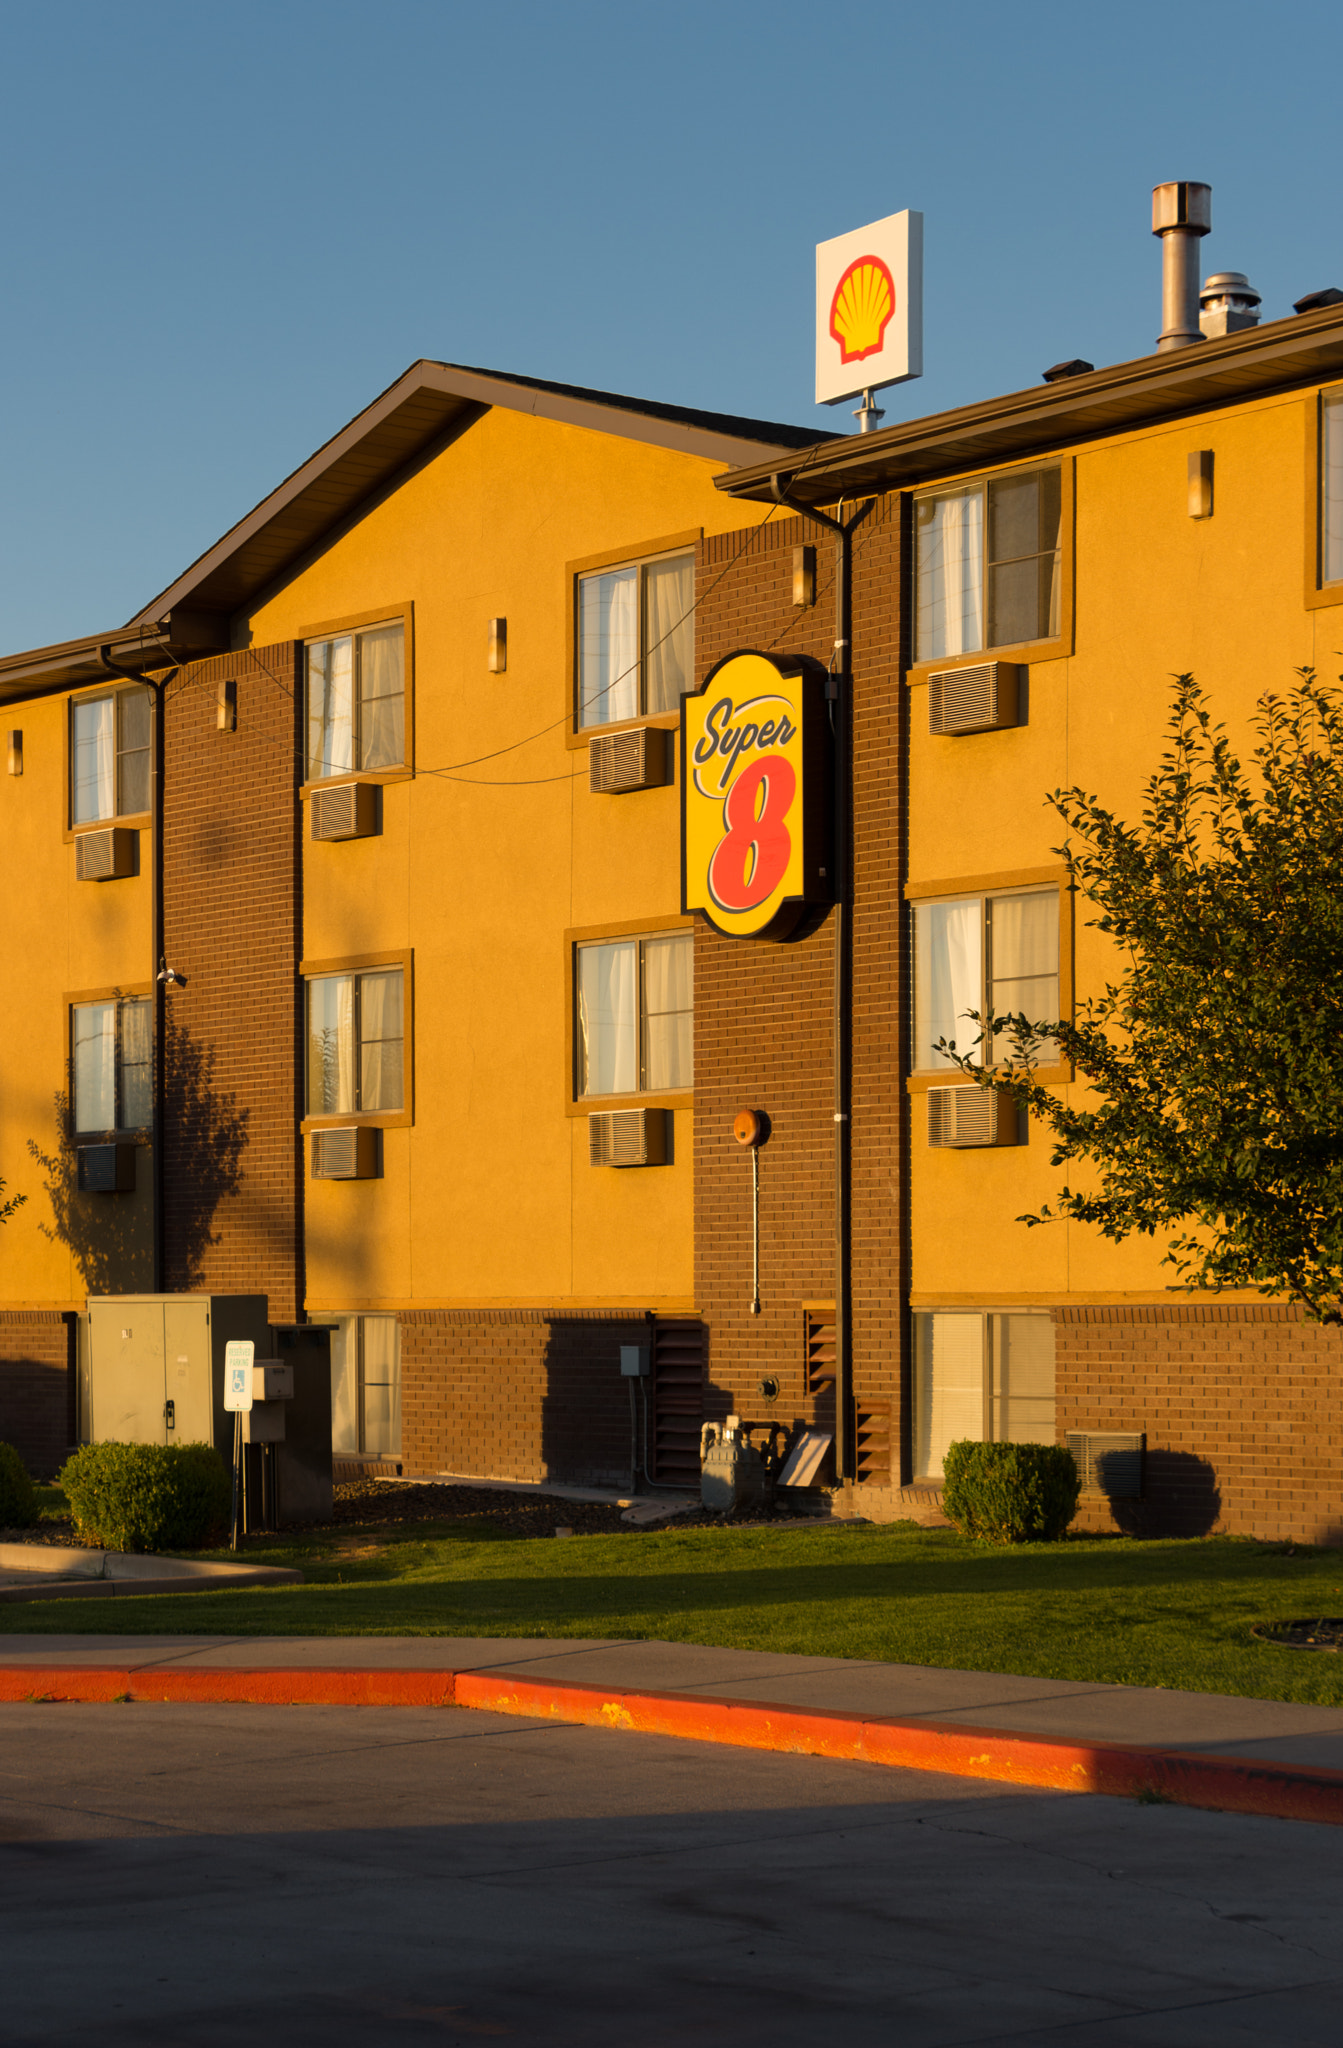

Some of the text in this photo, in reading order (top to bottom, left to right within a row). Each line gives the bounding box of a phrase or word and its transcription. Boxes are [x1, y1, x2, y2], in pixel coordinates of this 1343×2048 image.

[693, 697, 797, 790] Super
[707, 754, 797, 914] 8
[228, 1348, 251, 1357] RESERVED
[229, 1358, 249, 1367] PARKING
